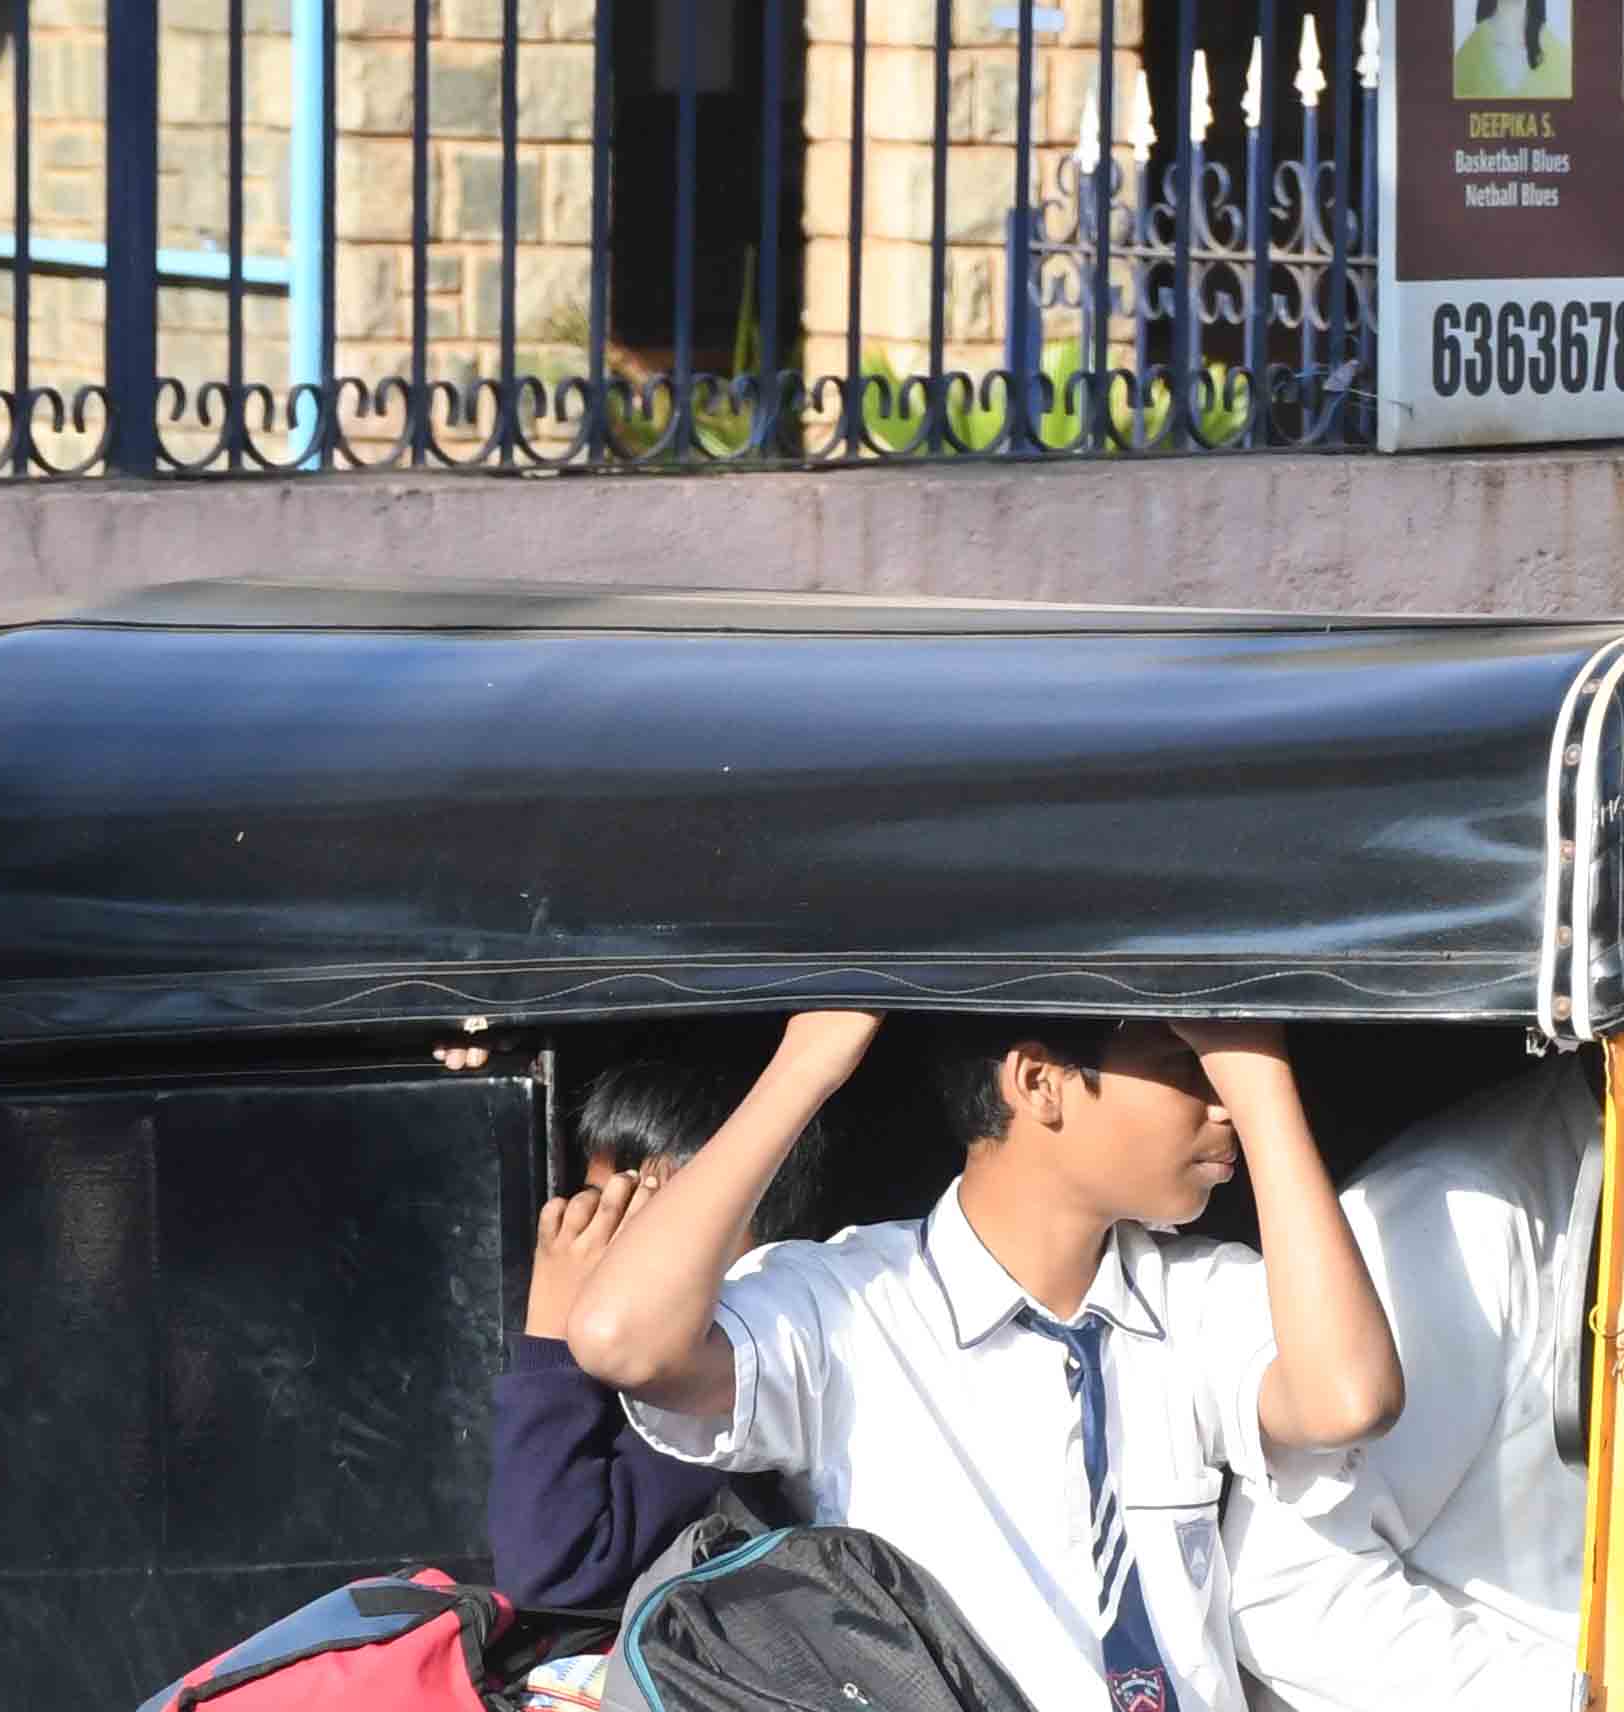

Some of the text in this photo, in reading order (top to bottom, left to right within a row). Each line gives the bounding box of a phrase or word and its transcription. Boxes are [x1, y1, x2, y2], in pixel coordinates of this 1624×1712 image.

[1469, 112, 1539, 138] DEEPIKA
[1455, 148, 1570, 173] Basketball Blues
[1465, 182, 1559, 207] Netball Blues
